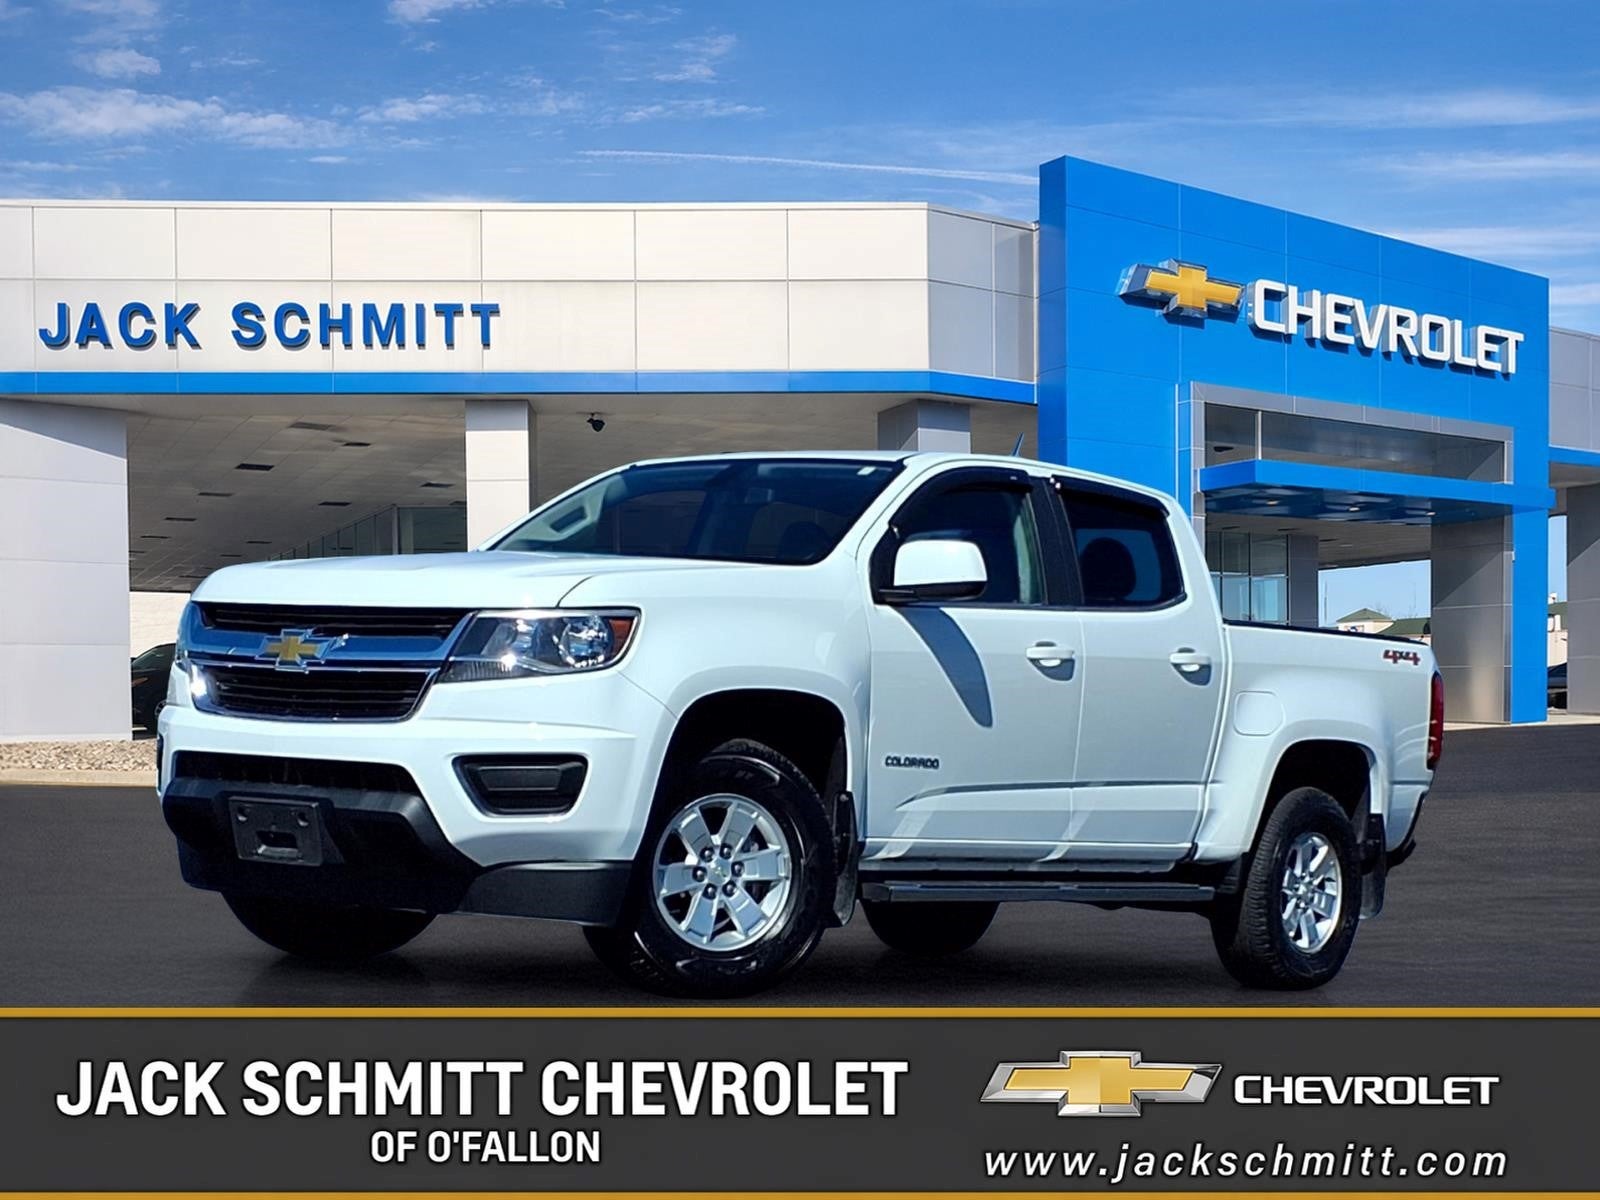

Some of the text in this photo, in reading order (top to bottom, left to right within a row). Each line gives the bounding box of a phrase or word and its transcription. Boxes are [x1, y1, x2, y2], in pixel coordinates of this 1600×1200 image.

[38, 301, 501, 349] JACK SCHMITT
[1249, 278, 1524, 376] CHEVROLET
